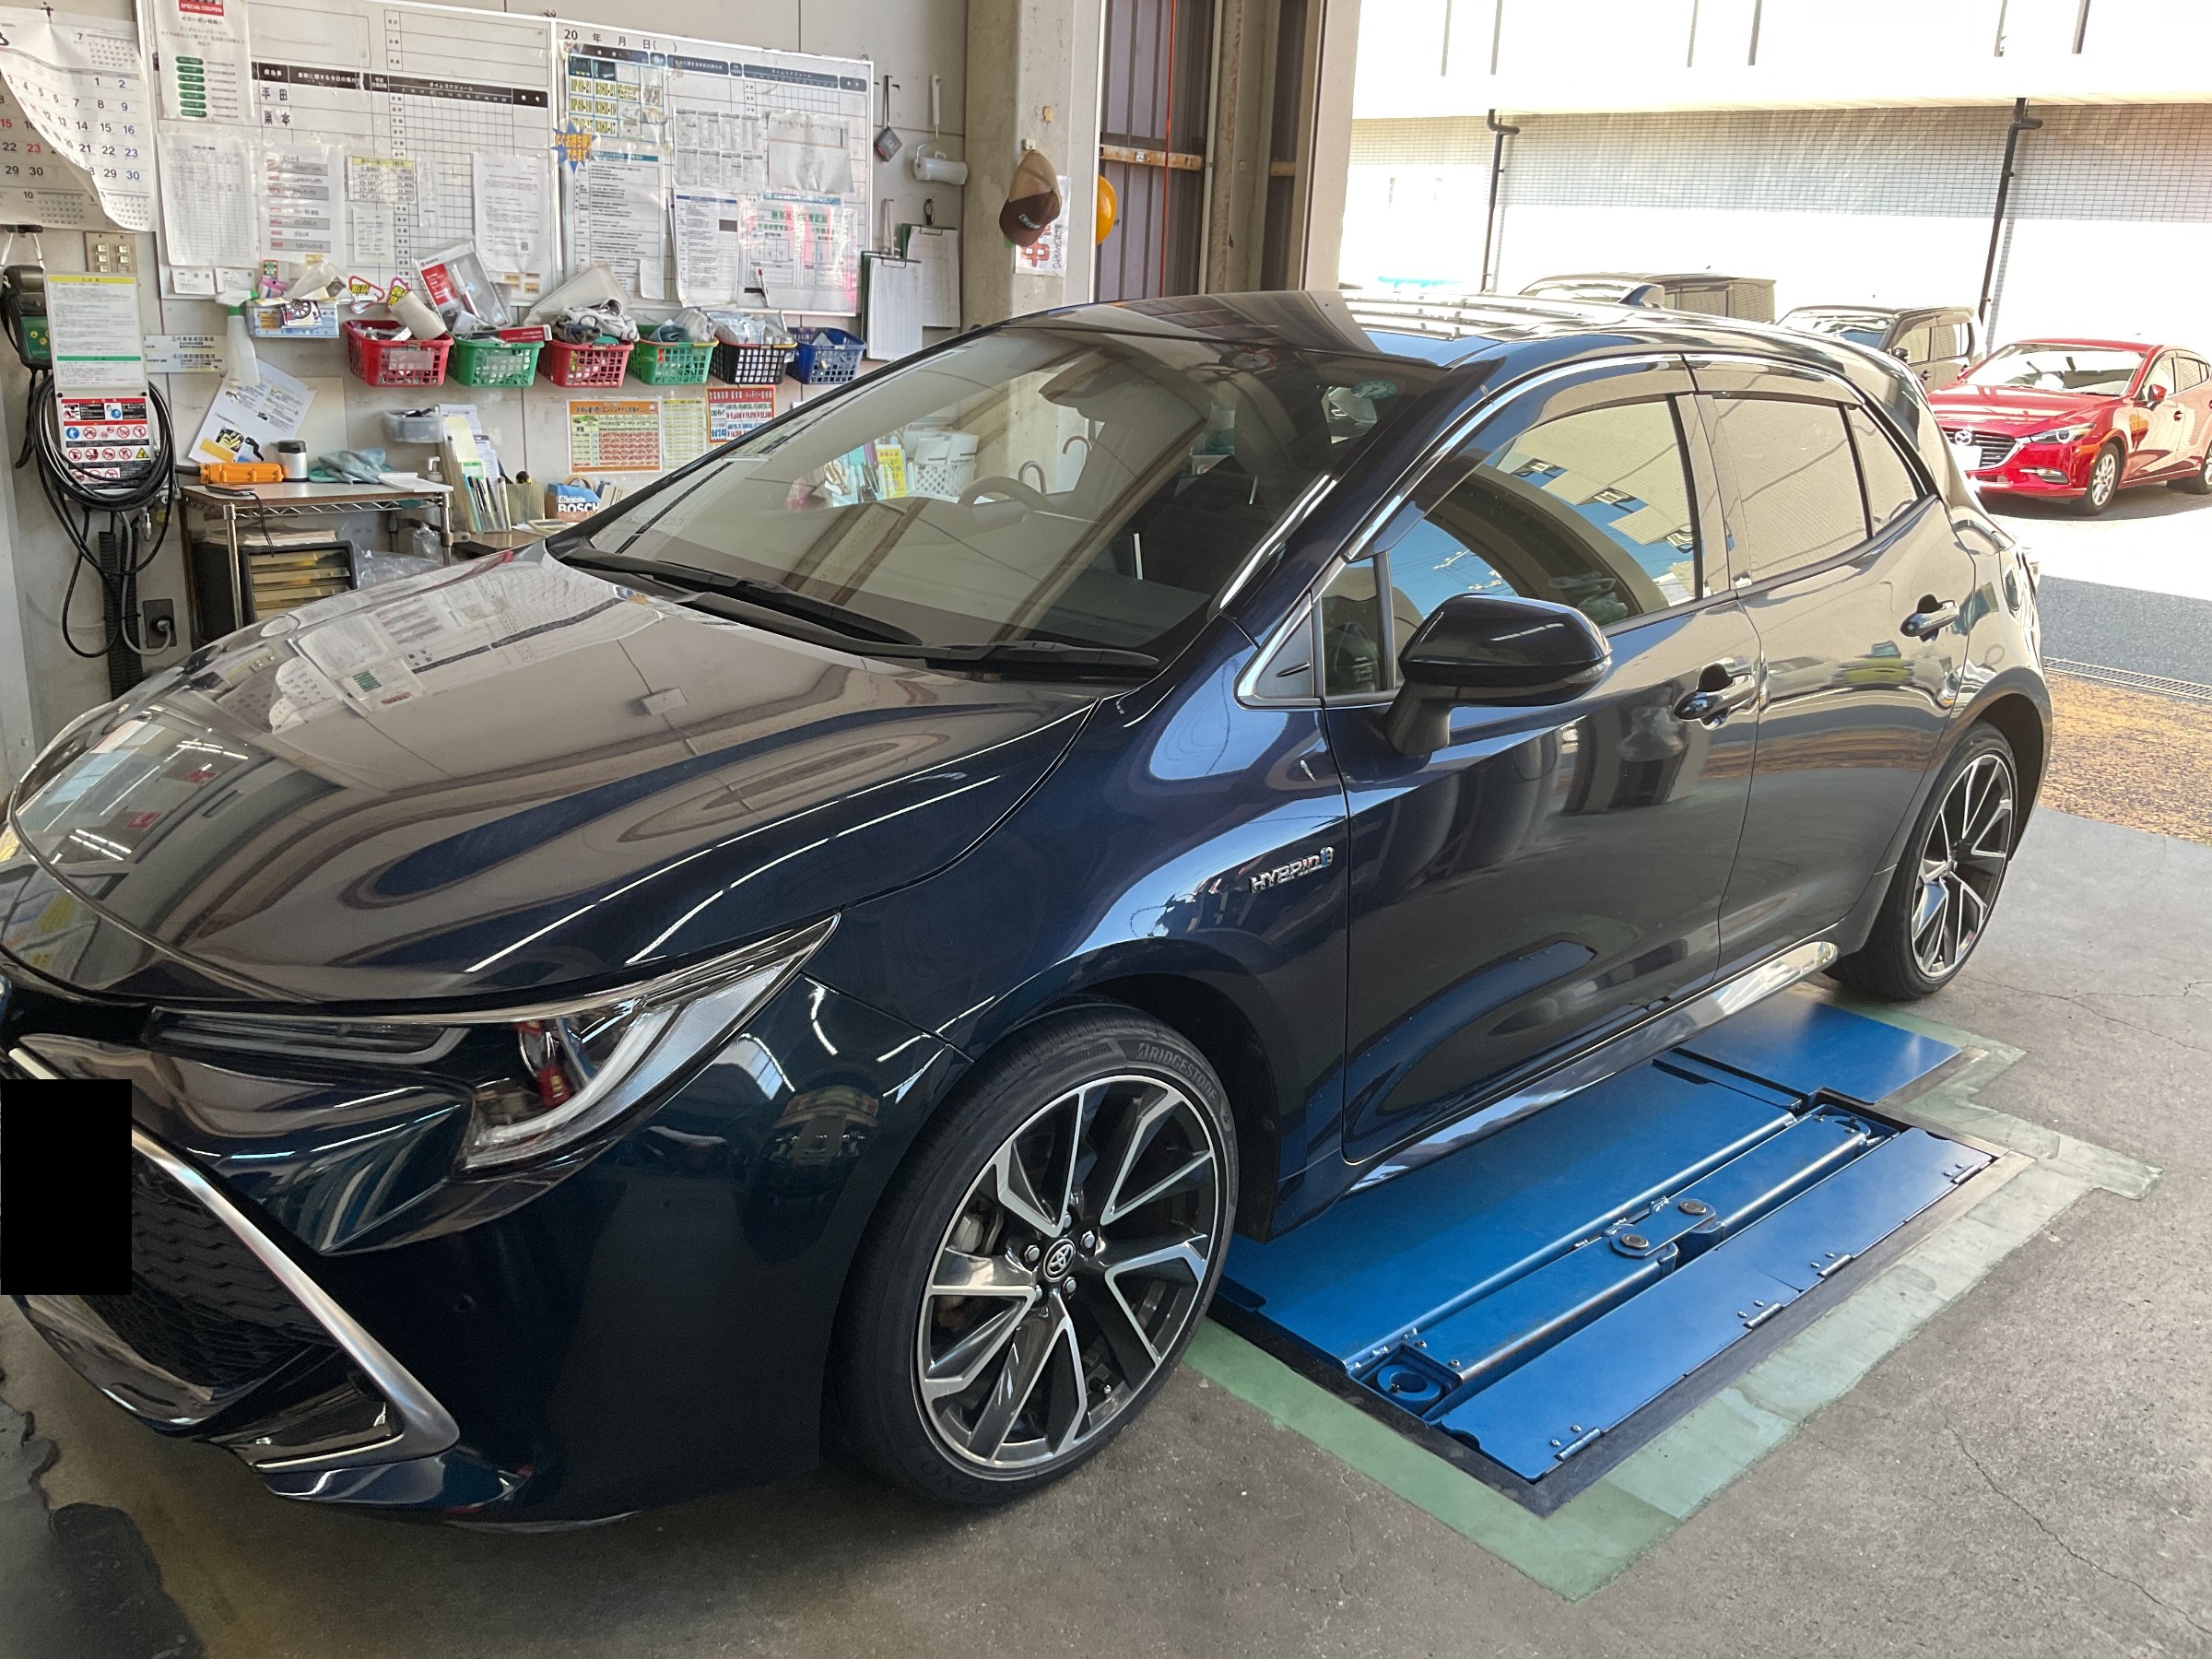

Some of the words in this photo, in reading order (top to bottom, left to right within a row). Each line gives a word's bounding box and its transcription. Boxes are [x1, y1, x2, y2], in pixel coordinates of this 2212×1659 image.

[564, 29, 578, 40] 20
[593, 32, 601, 43] 年
[618, 36, 626, 46] 月
[94, 77, 100, 86] 1
[118, 79, 126, 88] 2
[23, 81, 29, 91] 4
[38, 87, 44, 97] 5
[53, 94, 59, 103] 6
[73, 98, 80, 107] 7
[98, 100, 105, 109] 8
[121, 102, 128, 112] 9
[58, 116, 67, 127] 13
[76, 121, 88, 131] 14
[100, 123, 112, 132] 15
[123, 125, 135, 135] 16
[3, 143, 17, 151] 22
[27, 144, 41, 153] 23
[79, 144, 91, 153] 21
[102, 146, 115, 155] 22
[125, 148, 138, 158] 23
[6, 166, 19, 174] 29
[29, 167, 43, 176] 30
[103, 169, 117, 178] 29
[126, 171, 140, 181] 30
[558, 502, 599, 512] BOSCH
[1250, 854, 1322, 893] HYBRID
[1135, 1042, 1218, 1100] BRIDGESTONE
